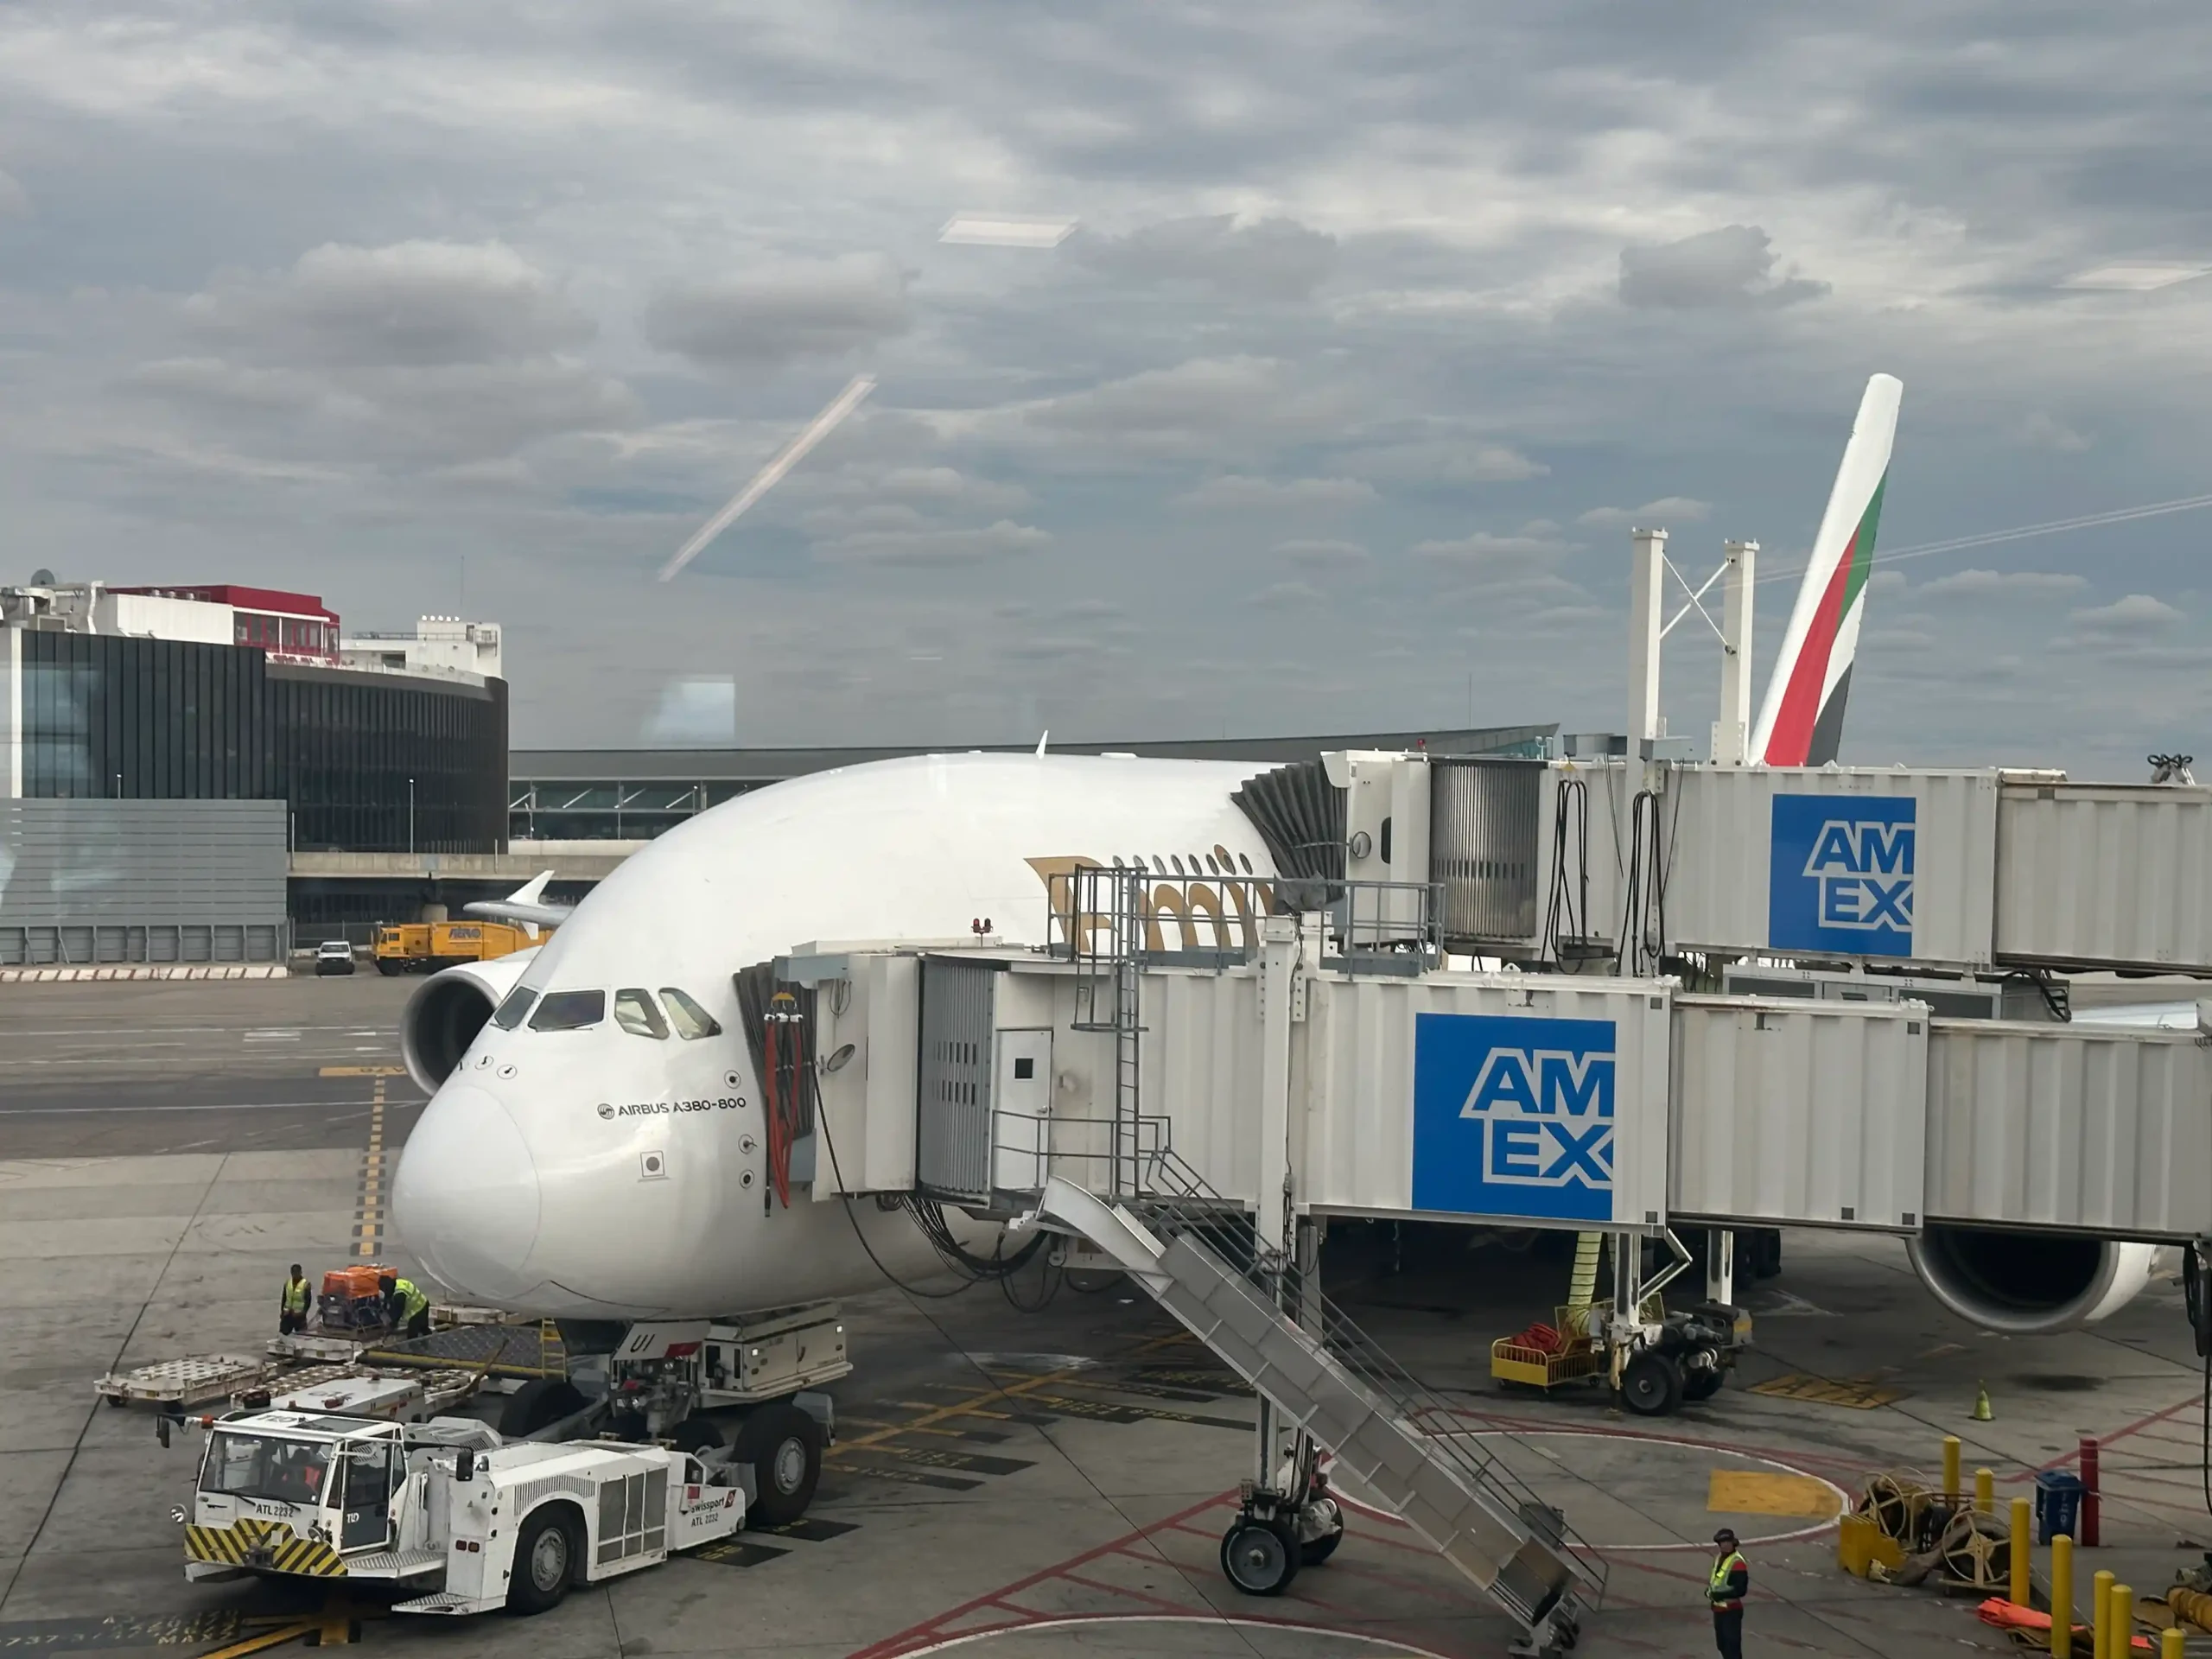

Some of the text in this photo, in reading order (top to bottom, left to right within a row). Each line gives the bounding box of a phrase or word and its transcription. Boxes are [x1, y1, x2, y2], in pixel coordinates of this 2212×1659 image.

[1807, 822, 1916, 877] AM
[1821, 876, 1913, 929] EX
[1465, 1050, 1615, 1121] AM
[618, 1097, 747, 1116] AIRBUS A380-800
[1486, 1118, 1613, 1185] EX
[256, 1503, 295, 1518] ATL 2232
[690, 1497, 725, 1513] swissport
[691, 1516, 703, 1528] ATL
